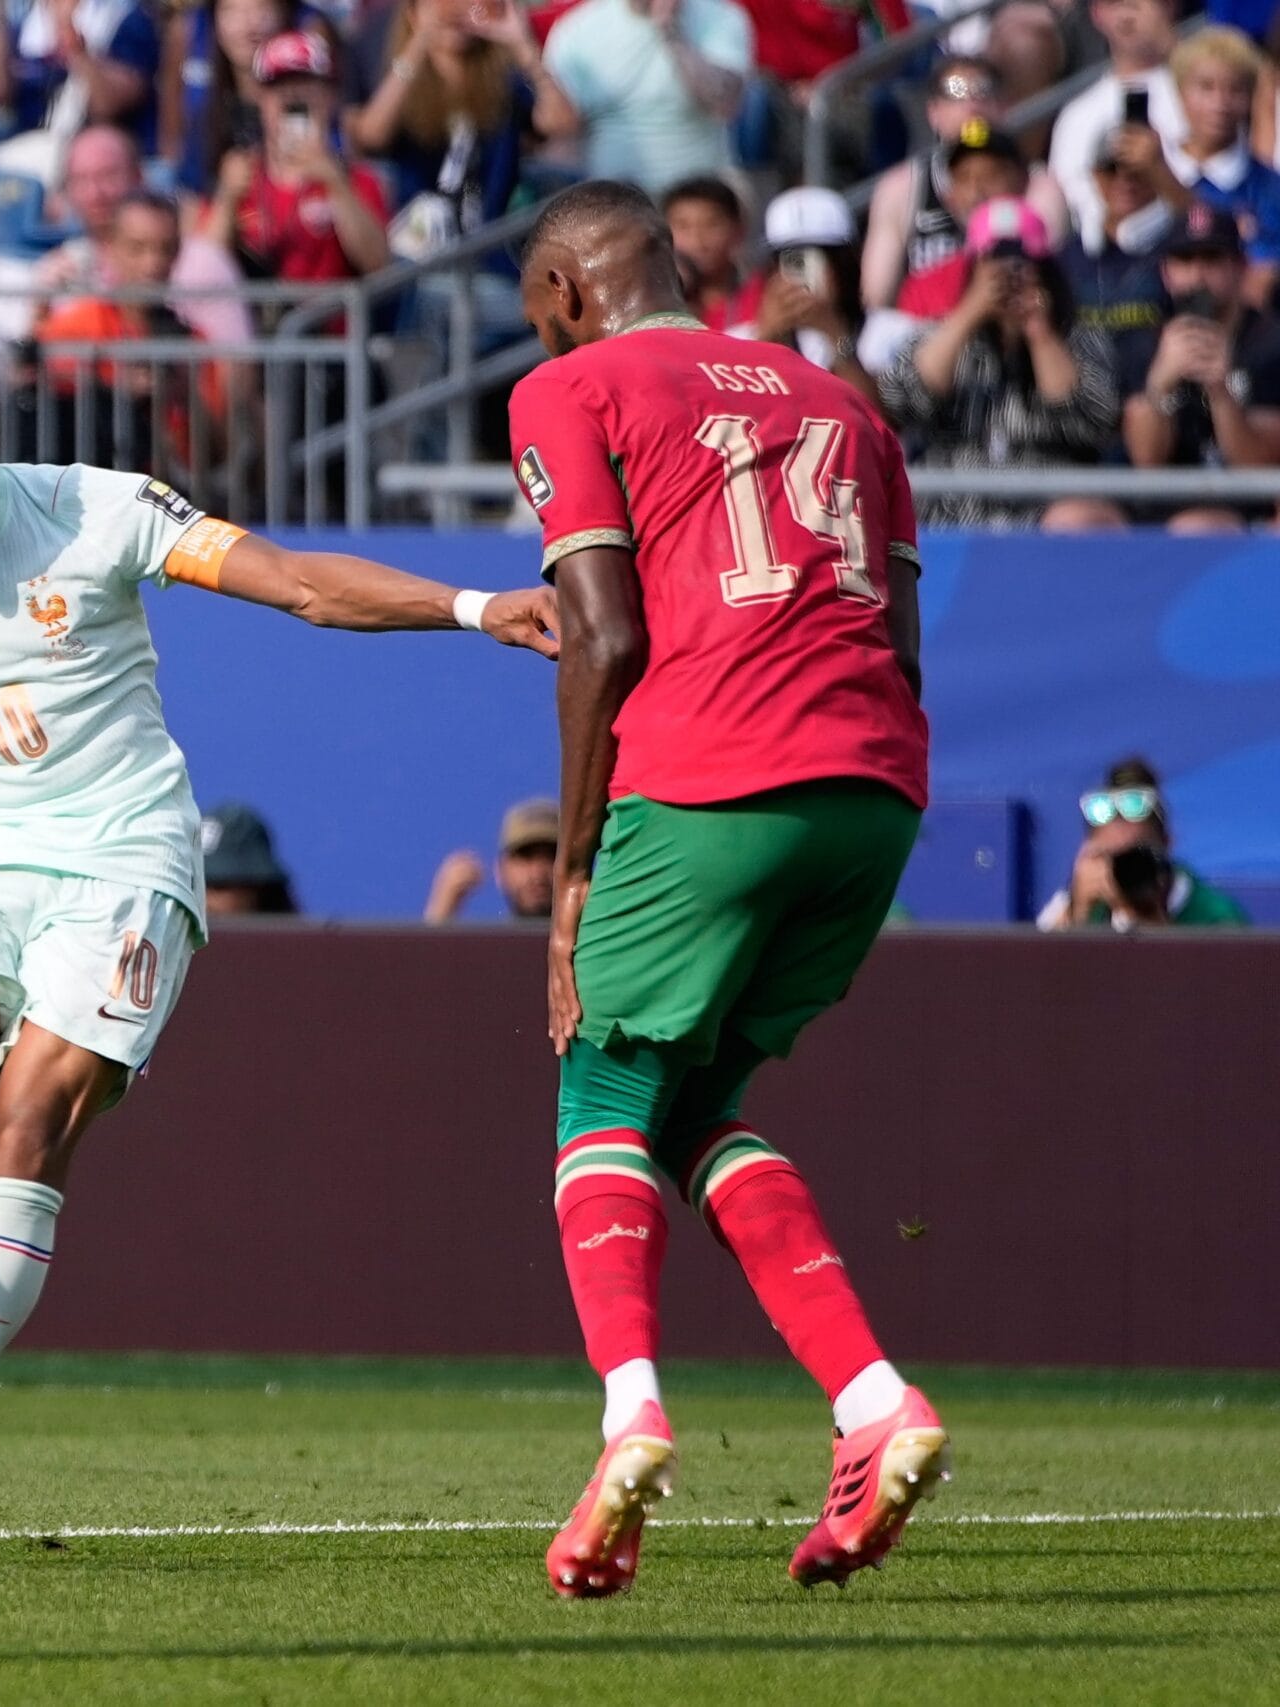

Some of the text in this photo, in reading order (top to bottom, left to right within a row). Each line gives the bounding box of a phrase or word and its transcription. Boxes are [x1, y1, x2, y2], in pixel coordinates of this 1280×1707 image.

[696, 361, 790, 396] ISSA
[693, 414, 885, 609] 14
[108, 930, 158, 1011] 10
